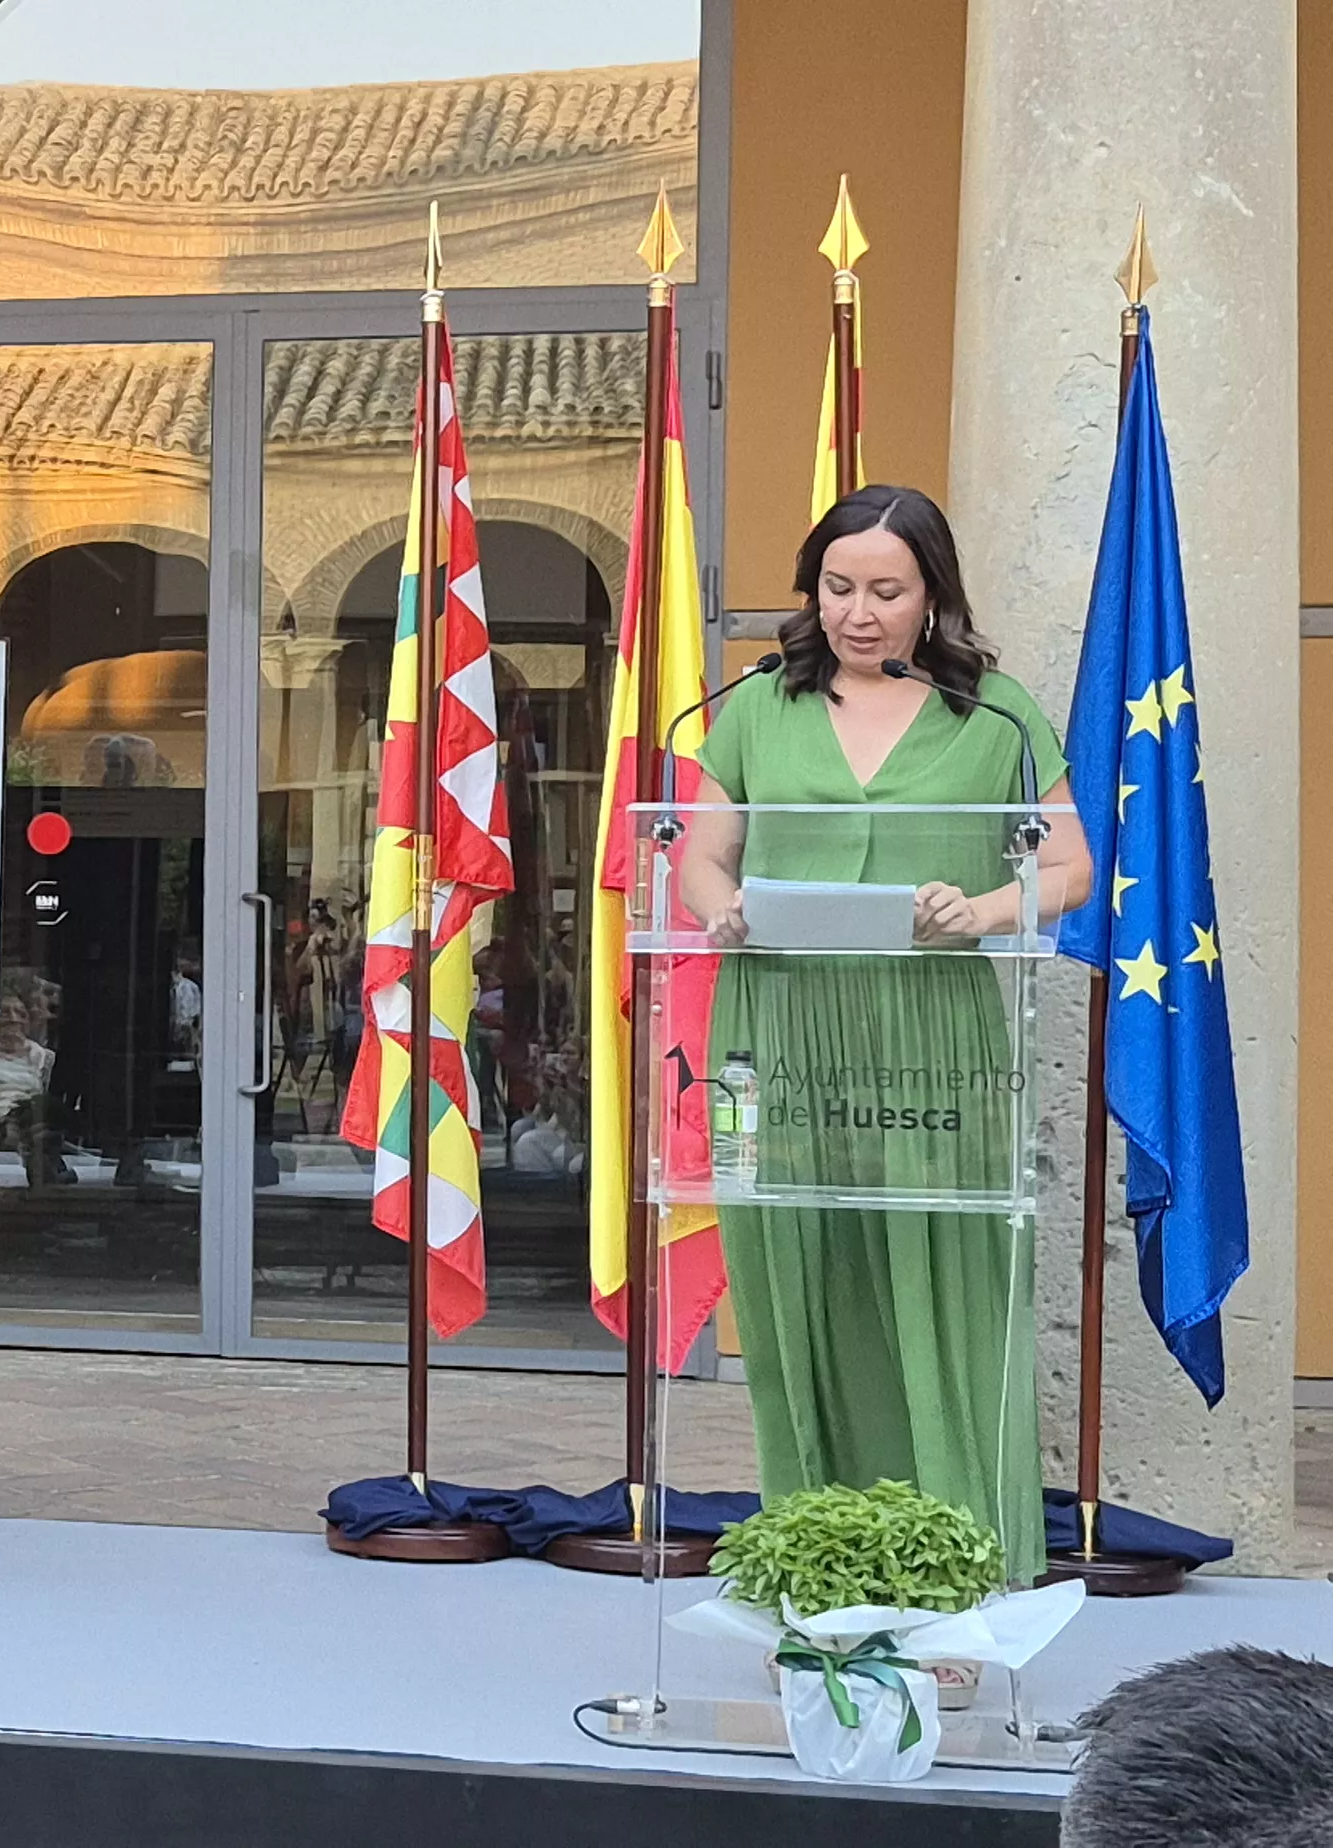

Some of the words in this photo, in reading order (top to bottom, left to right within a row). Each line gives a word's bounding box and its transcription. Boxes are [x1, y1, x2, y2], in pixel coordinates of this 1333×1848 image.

[769, 1056, 1026, 1095] Ayuntamiento
[767, 1098, 809, 1127] de
[824, 1098, 961, 1132] Huesca
